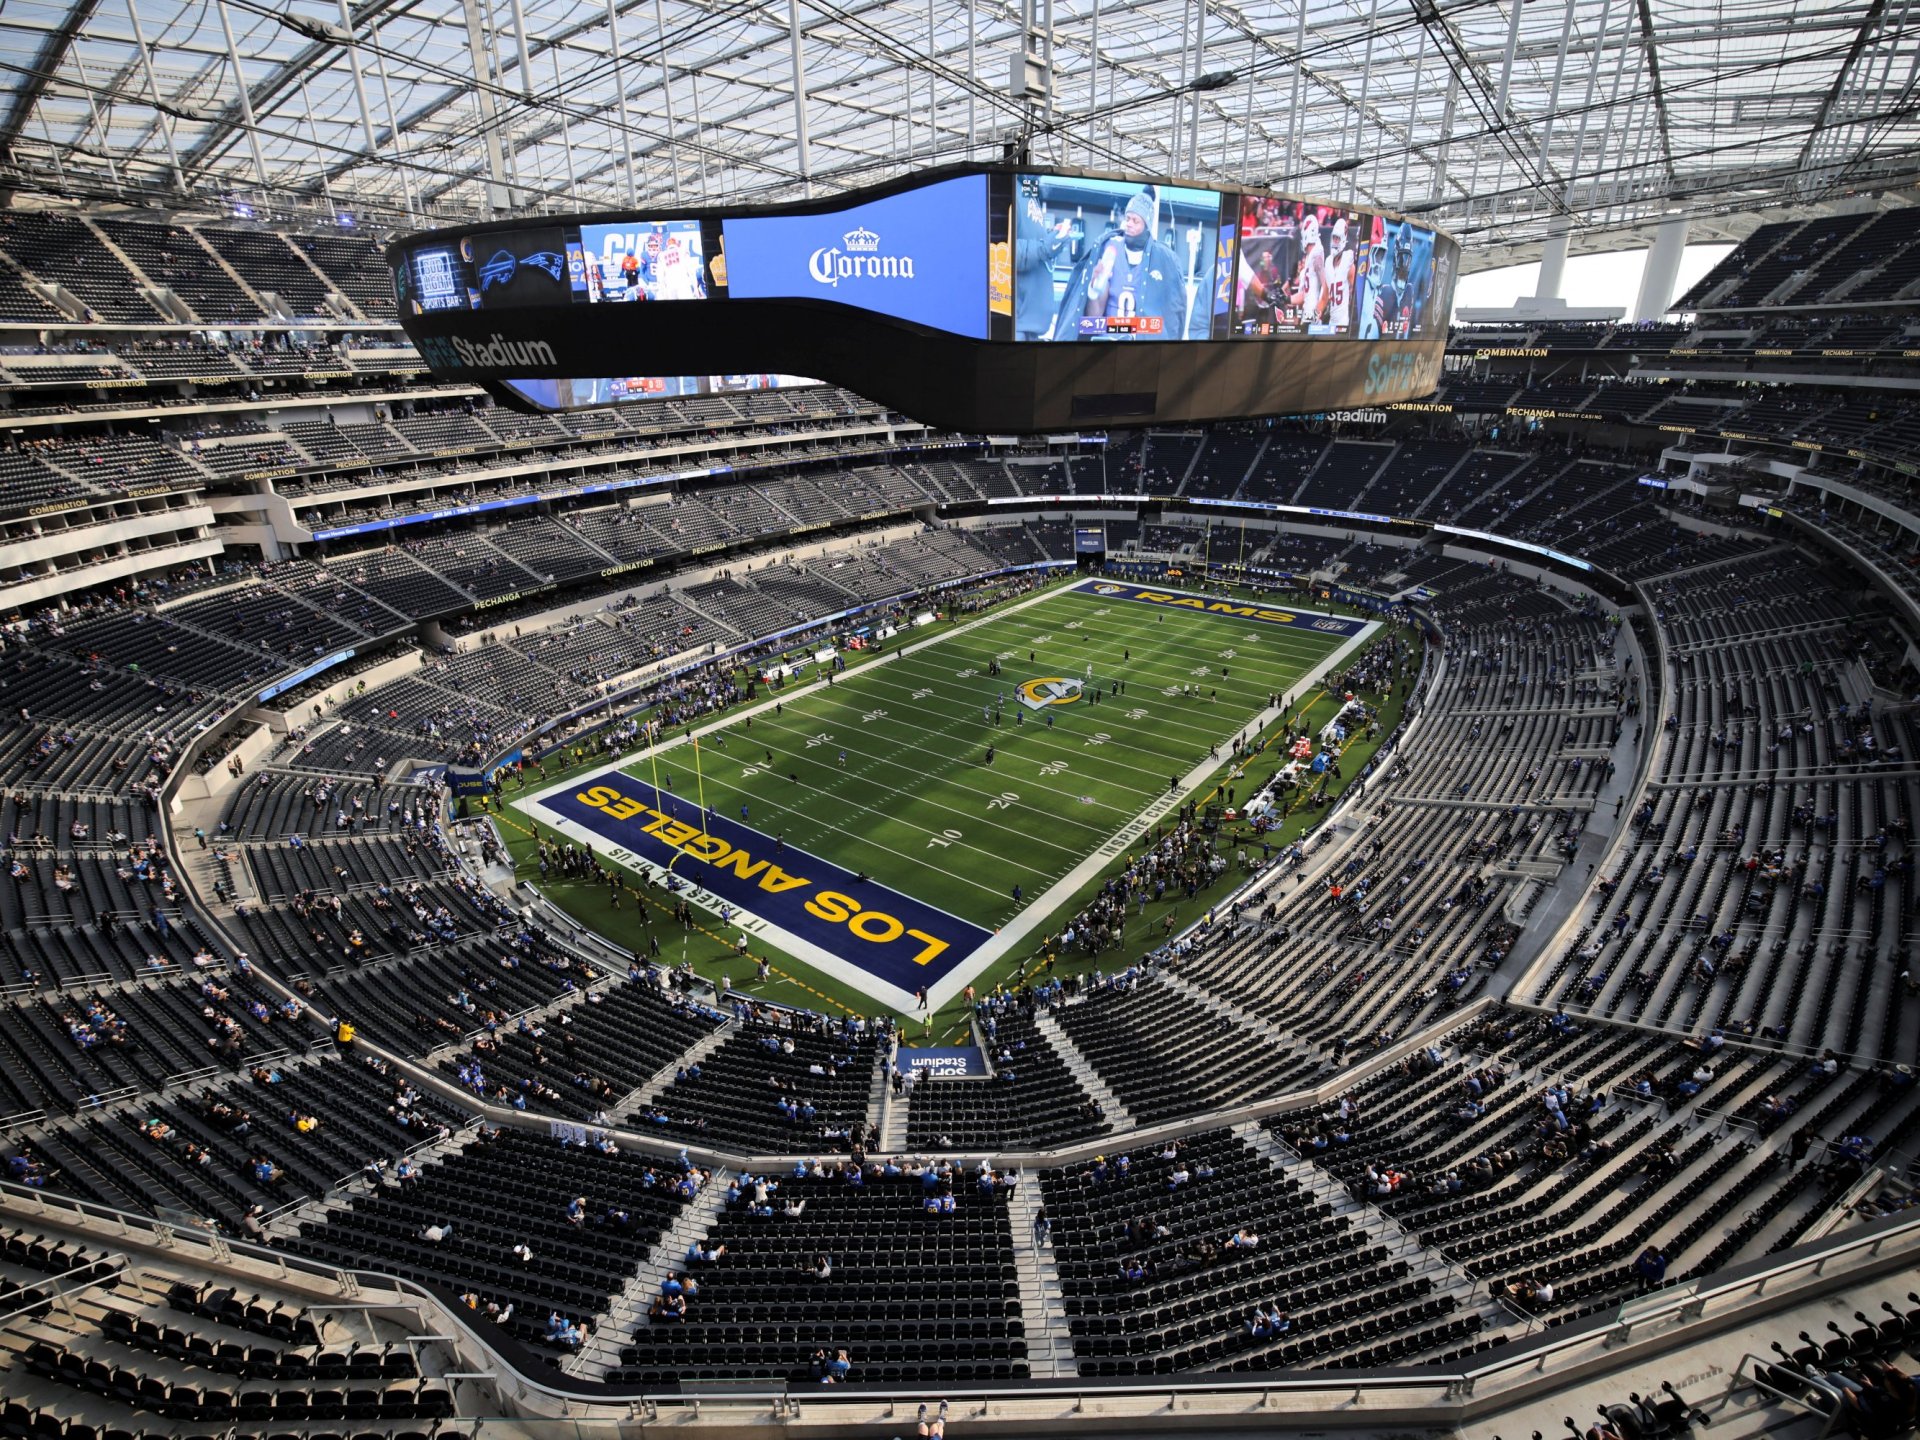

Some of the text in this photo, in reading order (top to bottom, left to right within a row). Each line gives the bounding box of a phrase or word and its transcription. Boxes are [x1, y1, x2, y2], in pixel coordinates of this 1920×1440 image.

[422, 258, 443, 274] BUD
[809, 247, 914, 288] Corona
[423, 275, 453, 291] LIGHT
[1329, 281, 1343, 307] 45
[423, 296, 462, 310] SPORTS BAR
[1095, 319, 1106, 329] 17
[1140, 319, 1146, 329] 0
[451, 333, 558, 368] Stadium
[1476, 348, 1548, 357] COMBINATION
[304, 371, 353, 380] COMBINATION
[389, 368, 420, 376] PECHANGA
[1365, 353, 1402, 395] SoFi
[86, 380, 149, 390] COMBINATION
[189, 376, 230, 385] PECHANGA
[1506, 408, 1556, 418] PECHANGA
[1658, 425, 1696, 433] COMBINATION
[433, 448, 476, 457] COMBINATION
[336, 459, 371, 468] PECHANGA
[244, 469, 296, 481] COMBINATION
[128, 486, 171, 498] PECHANGA
[29, 499, 88, 516] COMBINATION
[860, 511, 889, 520] PECHANGA
[789, 521, 831, 534] COMBINATION
[691, 542, 727, 555] PECHANGA
[601, 558, 654, 577] COMBINATION
[1338, 584, 1361, 594] PECHANGA
[474, 583, 558, 610] PECHANGA RESORT CASINO
[1134, 592, 1296, 623] RAMS
[1125, 708, 1149, 719] 50
[805, 733, 834, 748] 20
[1088, 732, 1111, 745] 40
[741, 761, 773, 778] 10
[1043, 760, 1069, 775] 30
[990, 792, 1020, 810] 20
[1099, 786, 1190, 857] INSPIRE CHANGE
[929, 829, 962, 848] 10
[608, 848, 632, 861] US
[576, 786, 951, 966] LOS ANGELES
[743, 918, 768, 932] IT
[911, 1058, 967, 1068] Stadium
